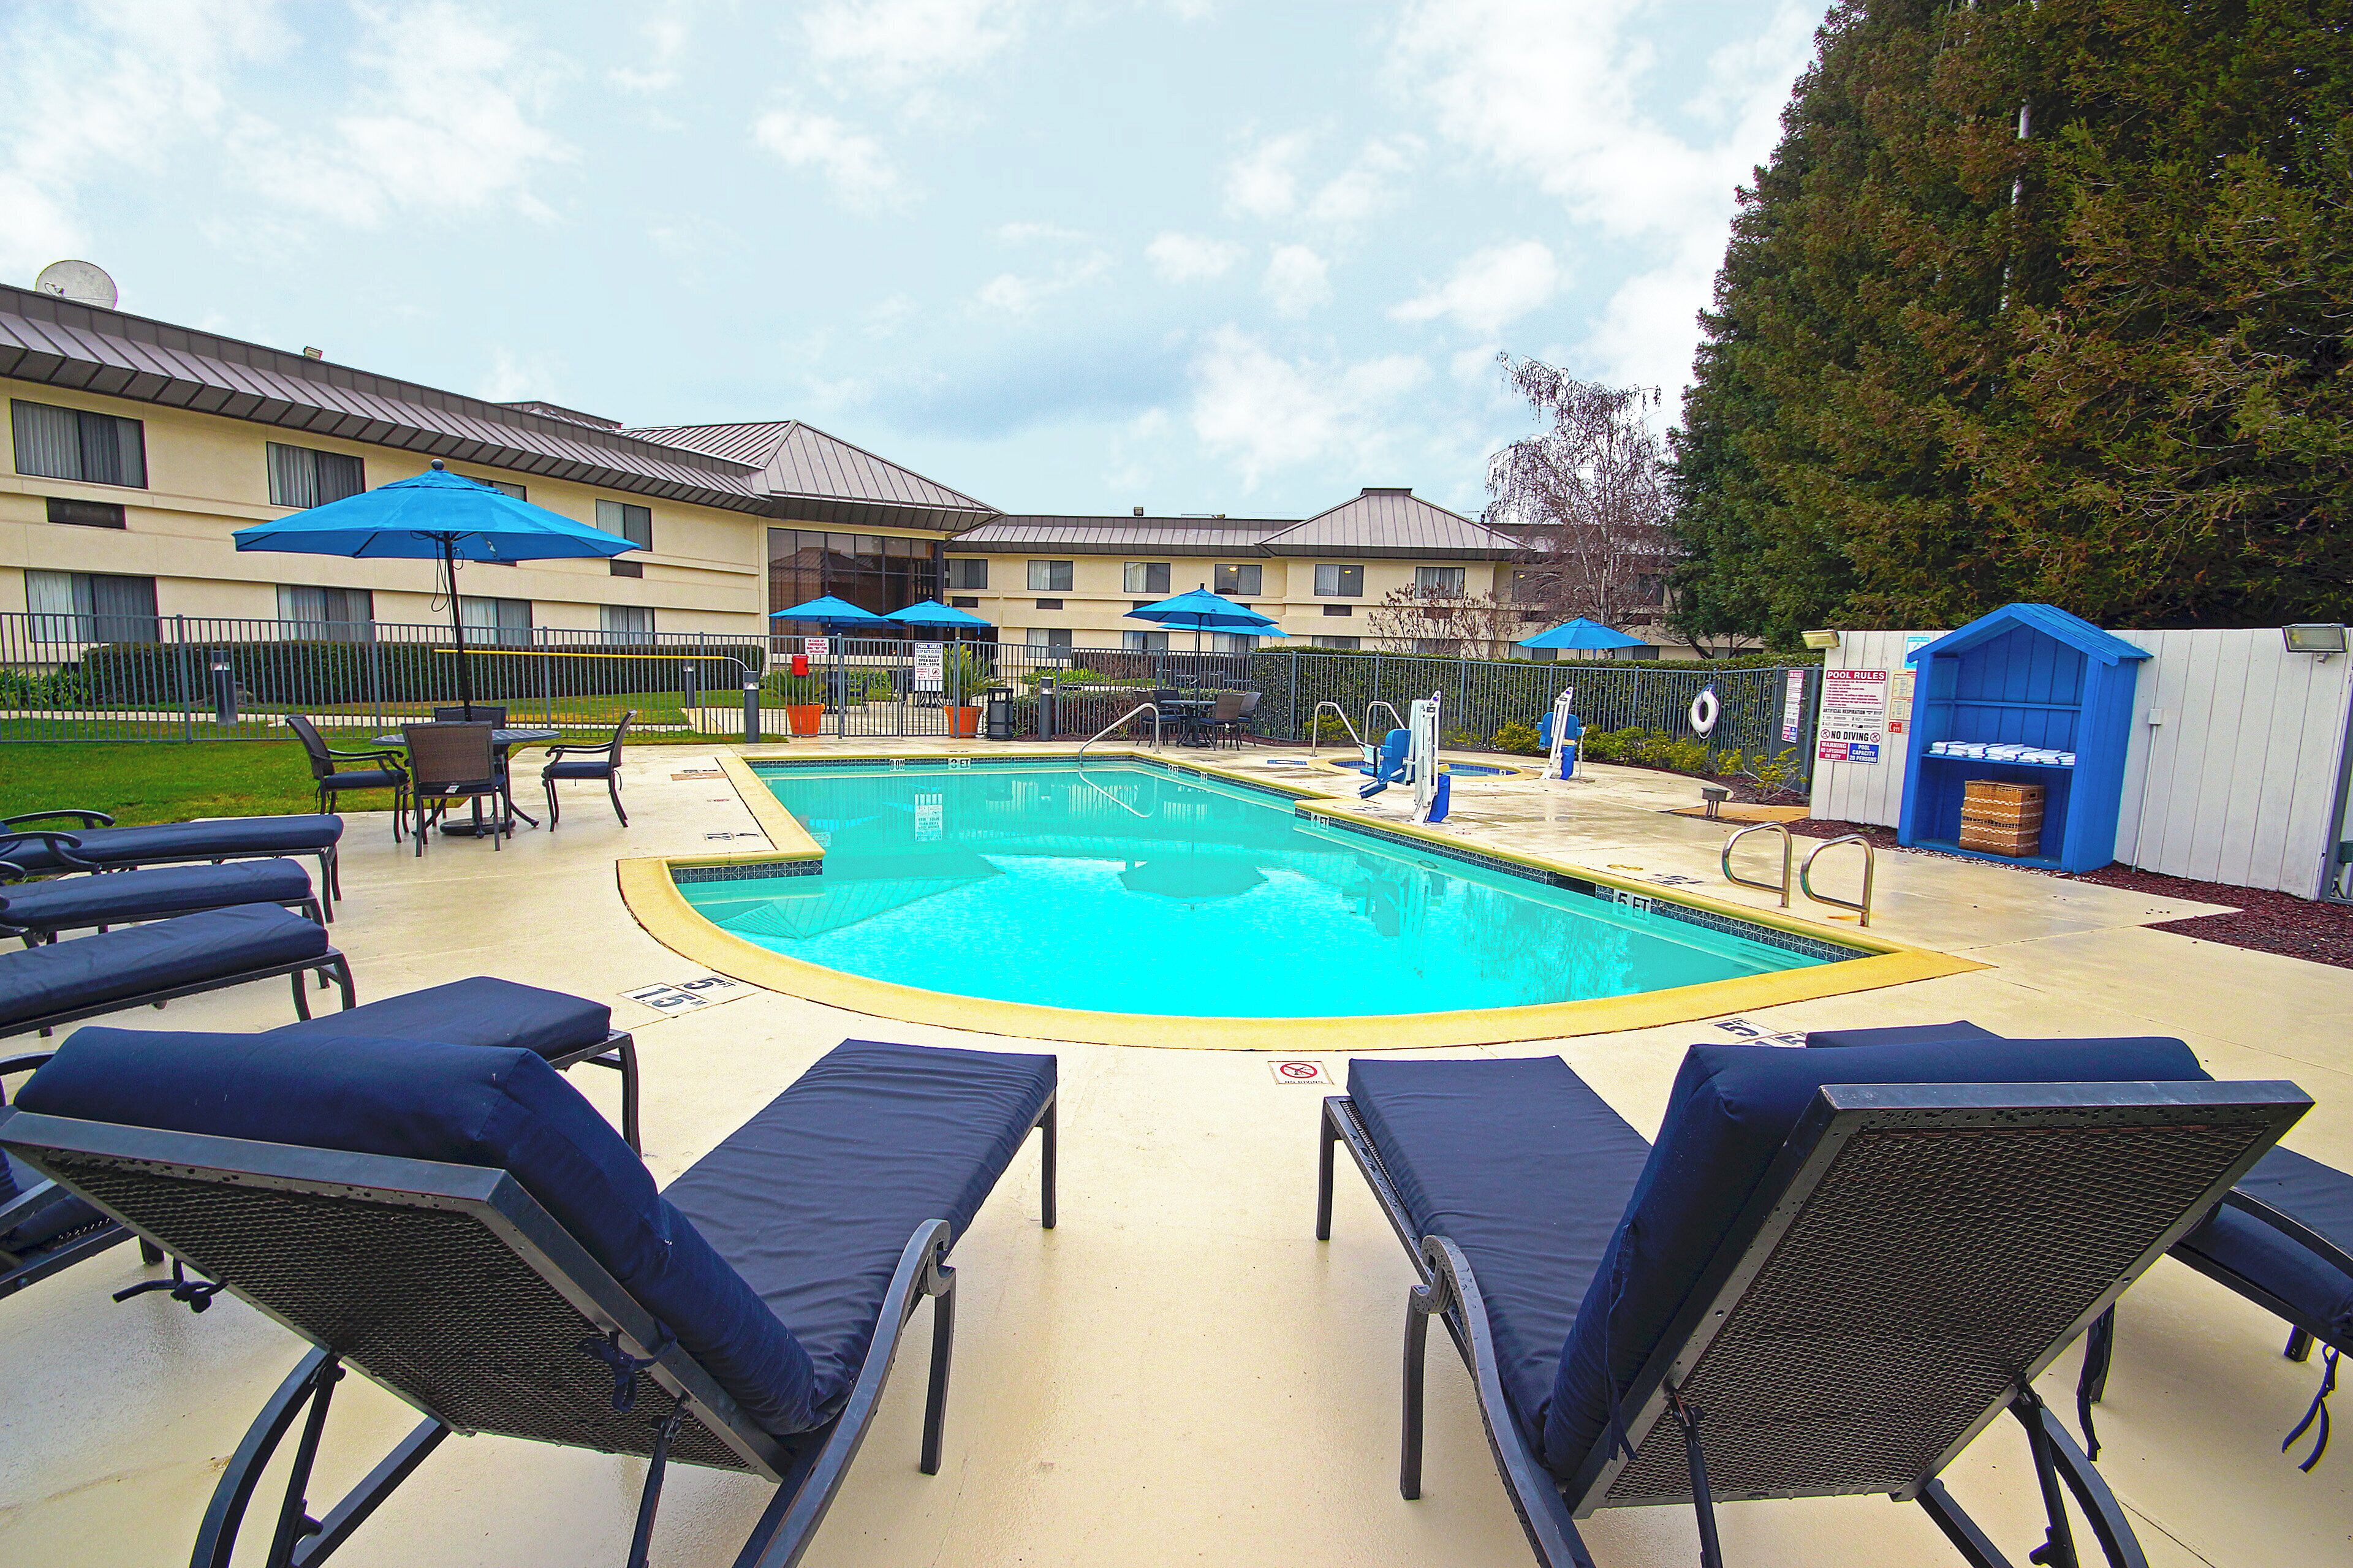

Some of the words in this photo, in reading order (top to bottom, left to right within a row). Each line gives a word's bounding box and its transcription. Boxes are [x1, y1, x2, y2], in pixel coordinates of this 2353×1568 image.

[1831, 730, 1841, 740] NO
[1843, 732, 1869, 741] DIVING
[1633, 896, 1650, 912] FT
[683, 977, 726, 990] 5
[1713, 1021, 1759, 1037] 5
